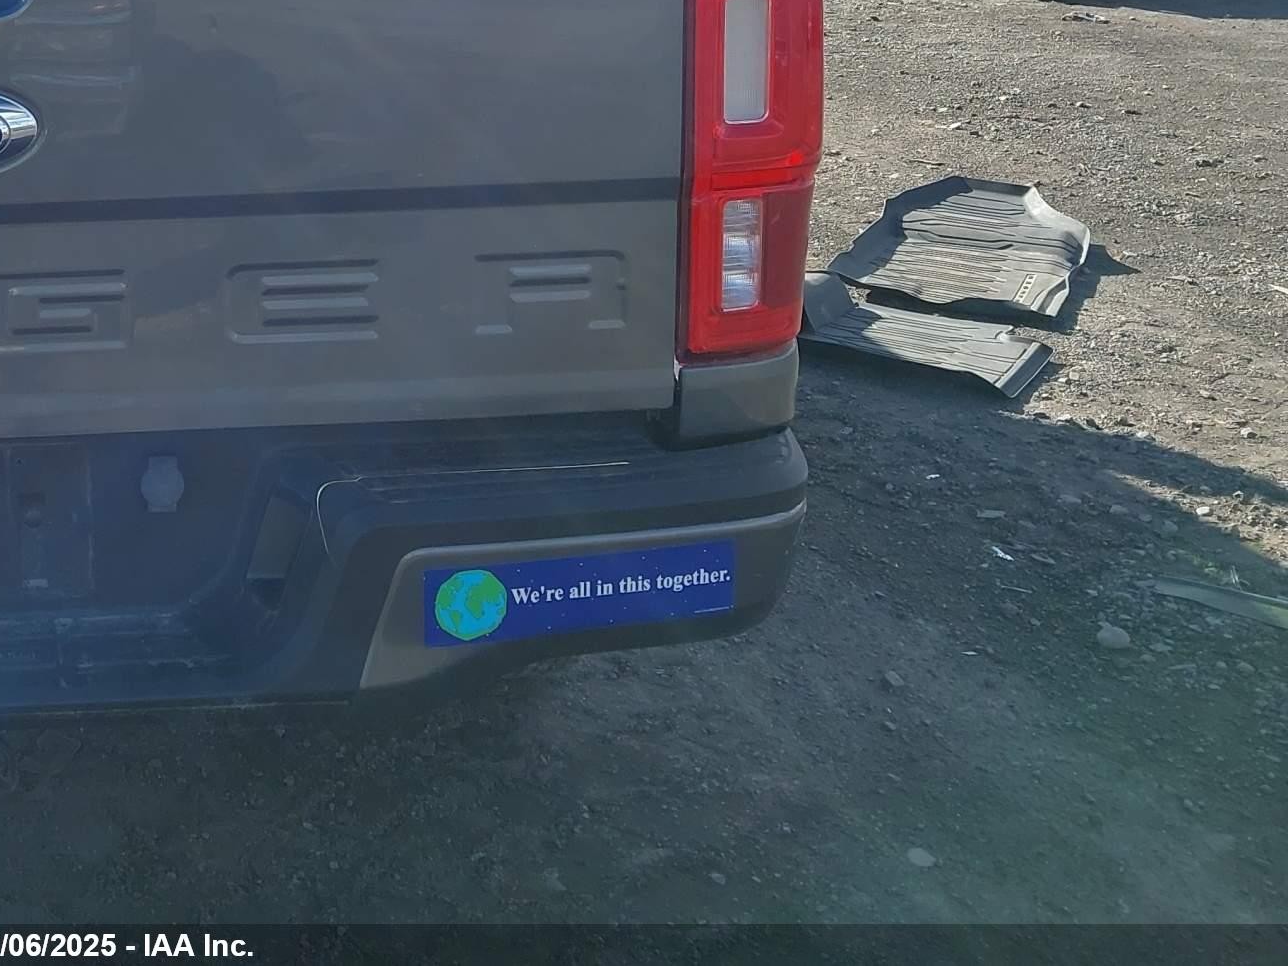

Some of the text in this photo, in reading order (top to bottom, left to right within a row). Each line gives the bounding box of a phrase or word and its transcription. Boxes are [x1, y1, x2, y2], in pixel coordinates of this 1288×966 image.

[511, 567, 732, 605] We're all in this together.
